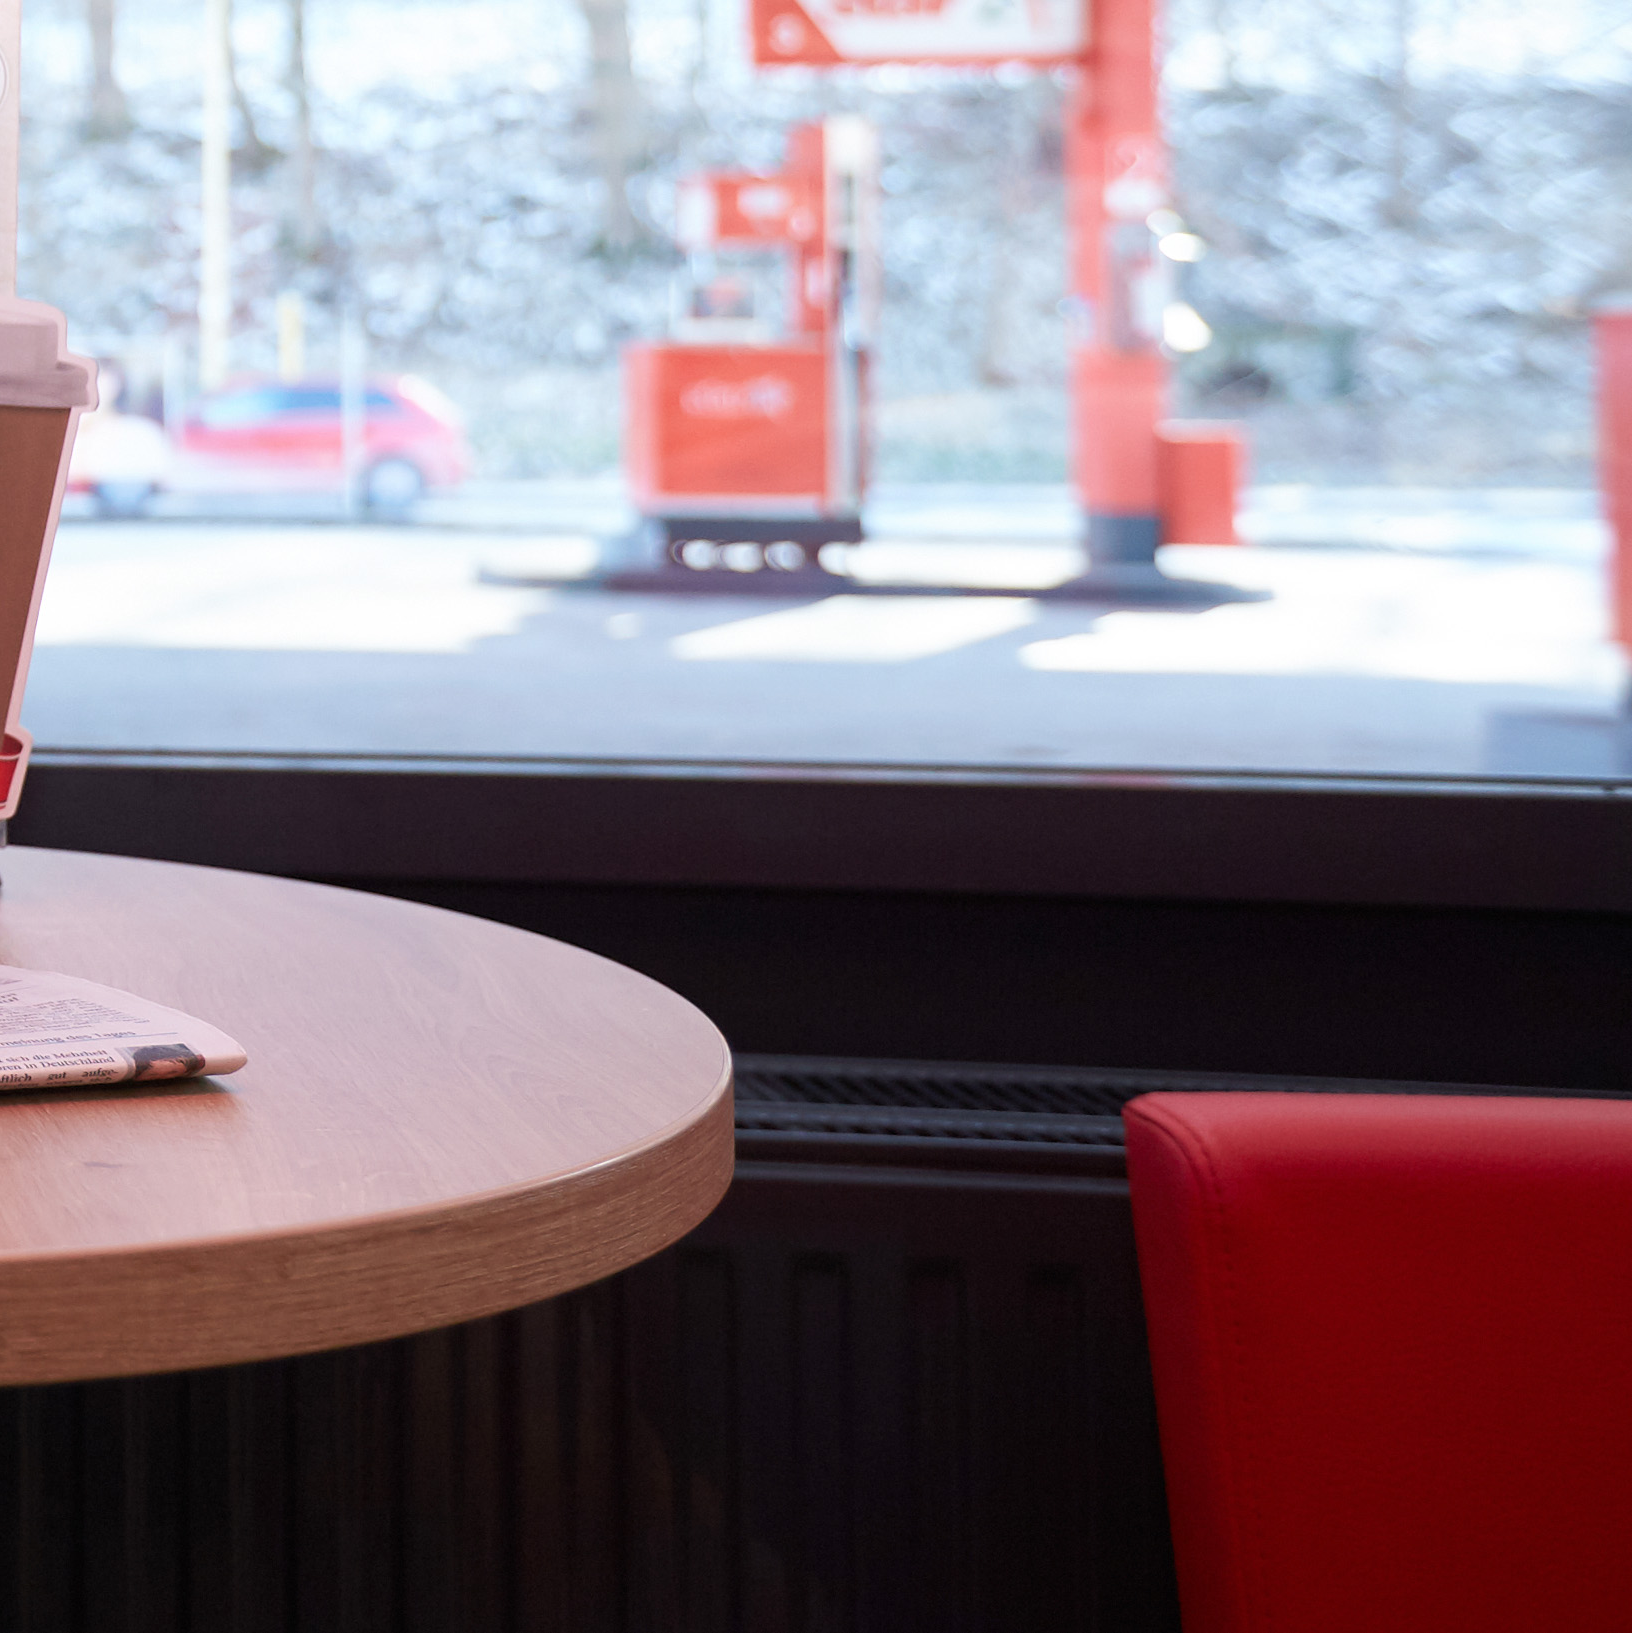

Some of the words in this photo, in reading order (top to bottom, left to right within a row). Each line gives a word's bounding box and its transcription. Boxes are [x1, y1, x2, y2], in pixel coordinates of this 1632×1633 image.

[93, 1030, 137, 1039] Tages
[5, 1055, 30, 1064] sich
[32, 1053, 51, 1061] die
[53, 1050, 108, 1059] Mehrheit
[24, 1061, 39, 1069] in
[40, 1056, 116, 1068] Deutschland
[47, 1071, 67, 1081] gut
